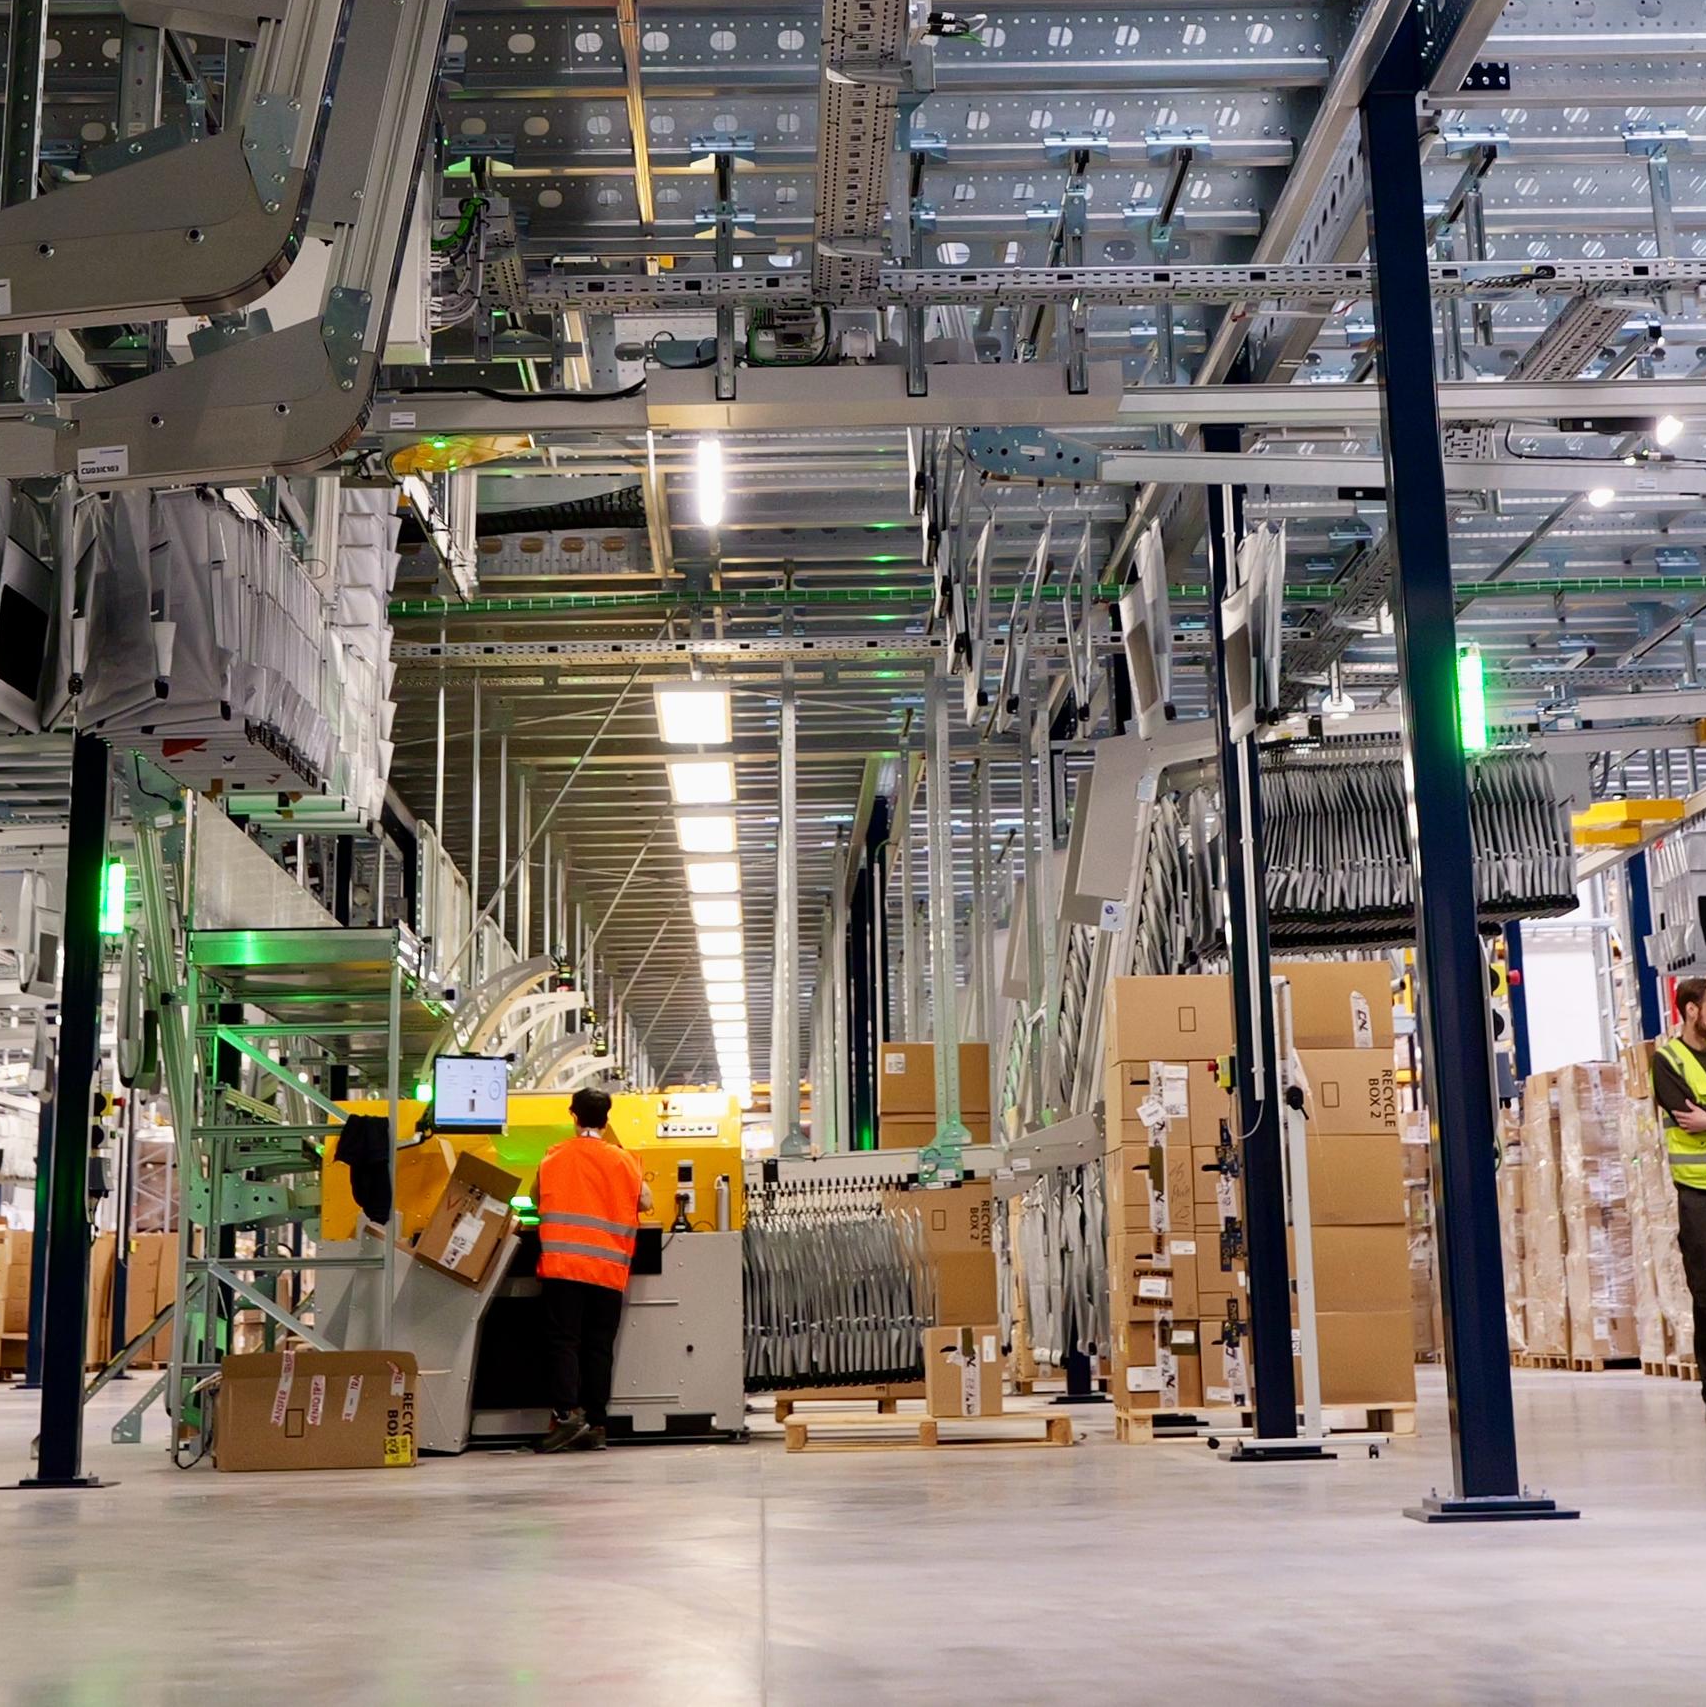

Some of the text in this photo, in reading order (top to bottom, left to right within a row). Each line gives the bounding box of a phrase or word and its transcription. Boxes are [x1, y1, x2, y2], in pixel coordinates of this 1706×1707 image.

[1368, 1078, 1381, 1107] BOX
[1382, 1069, 1396, 1127] RECYCLE
[969, 1207, 979, 1231] BOX
[980, 1200, 991, 1247] RECYCLE
